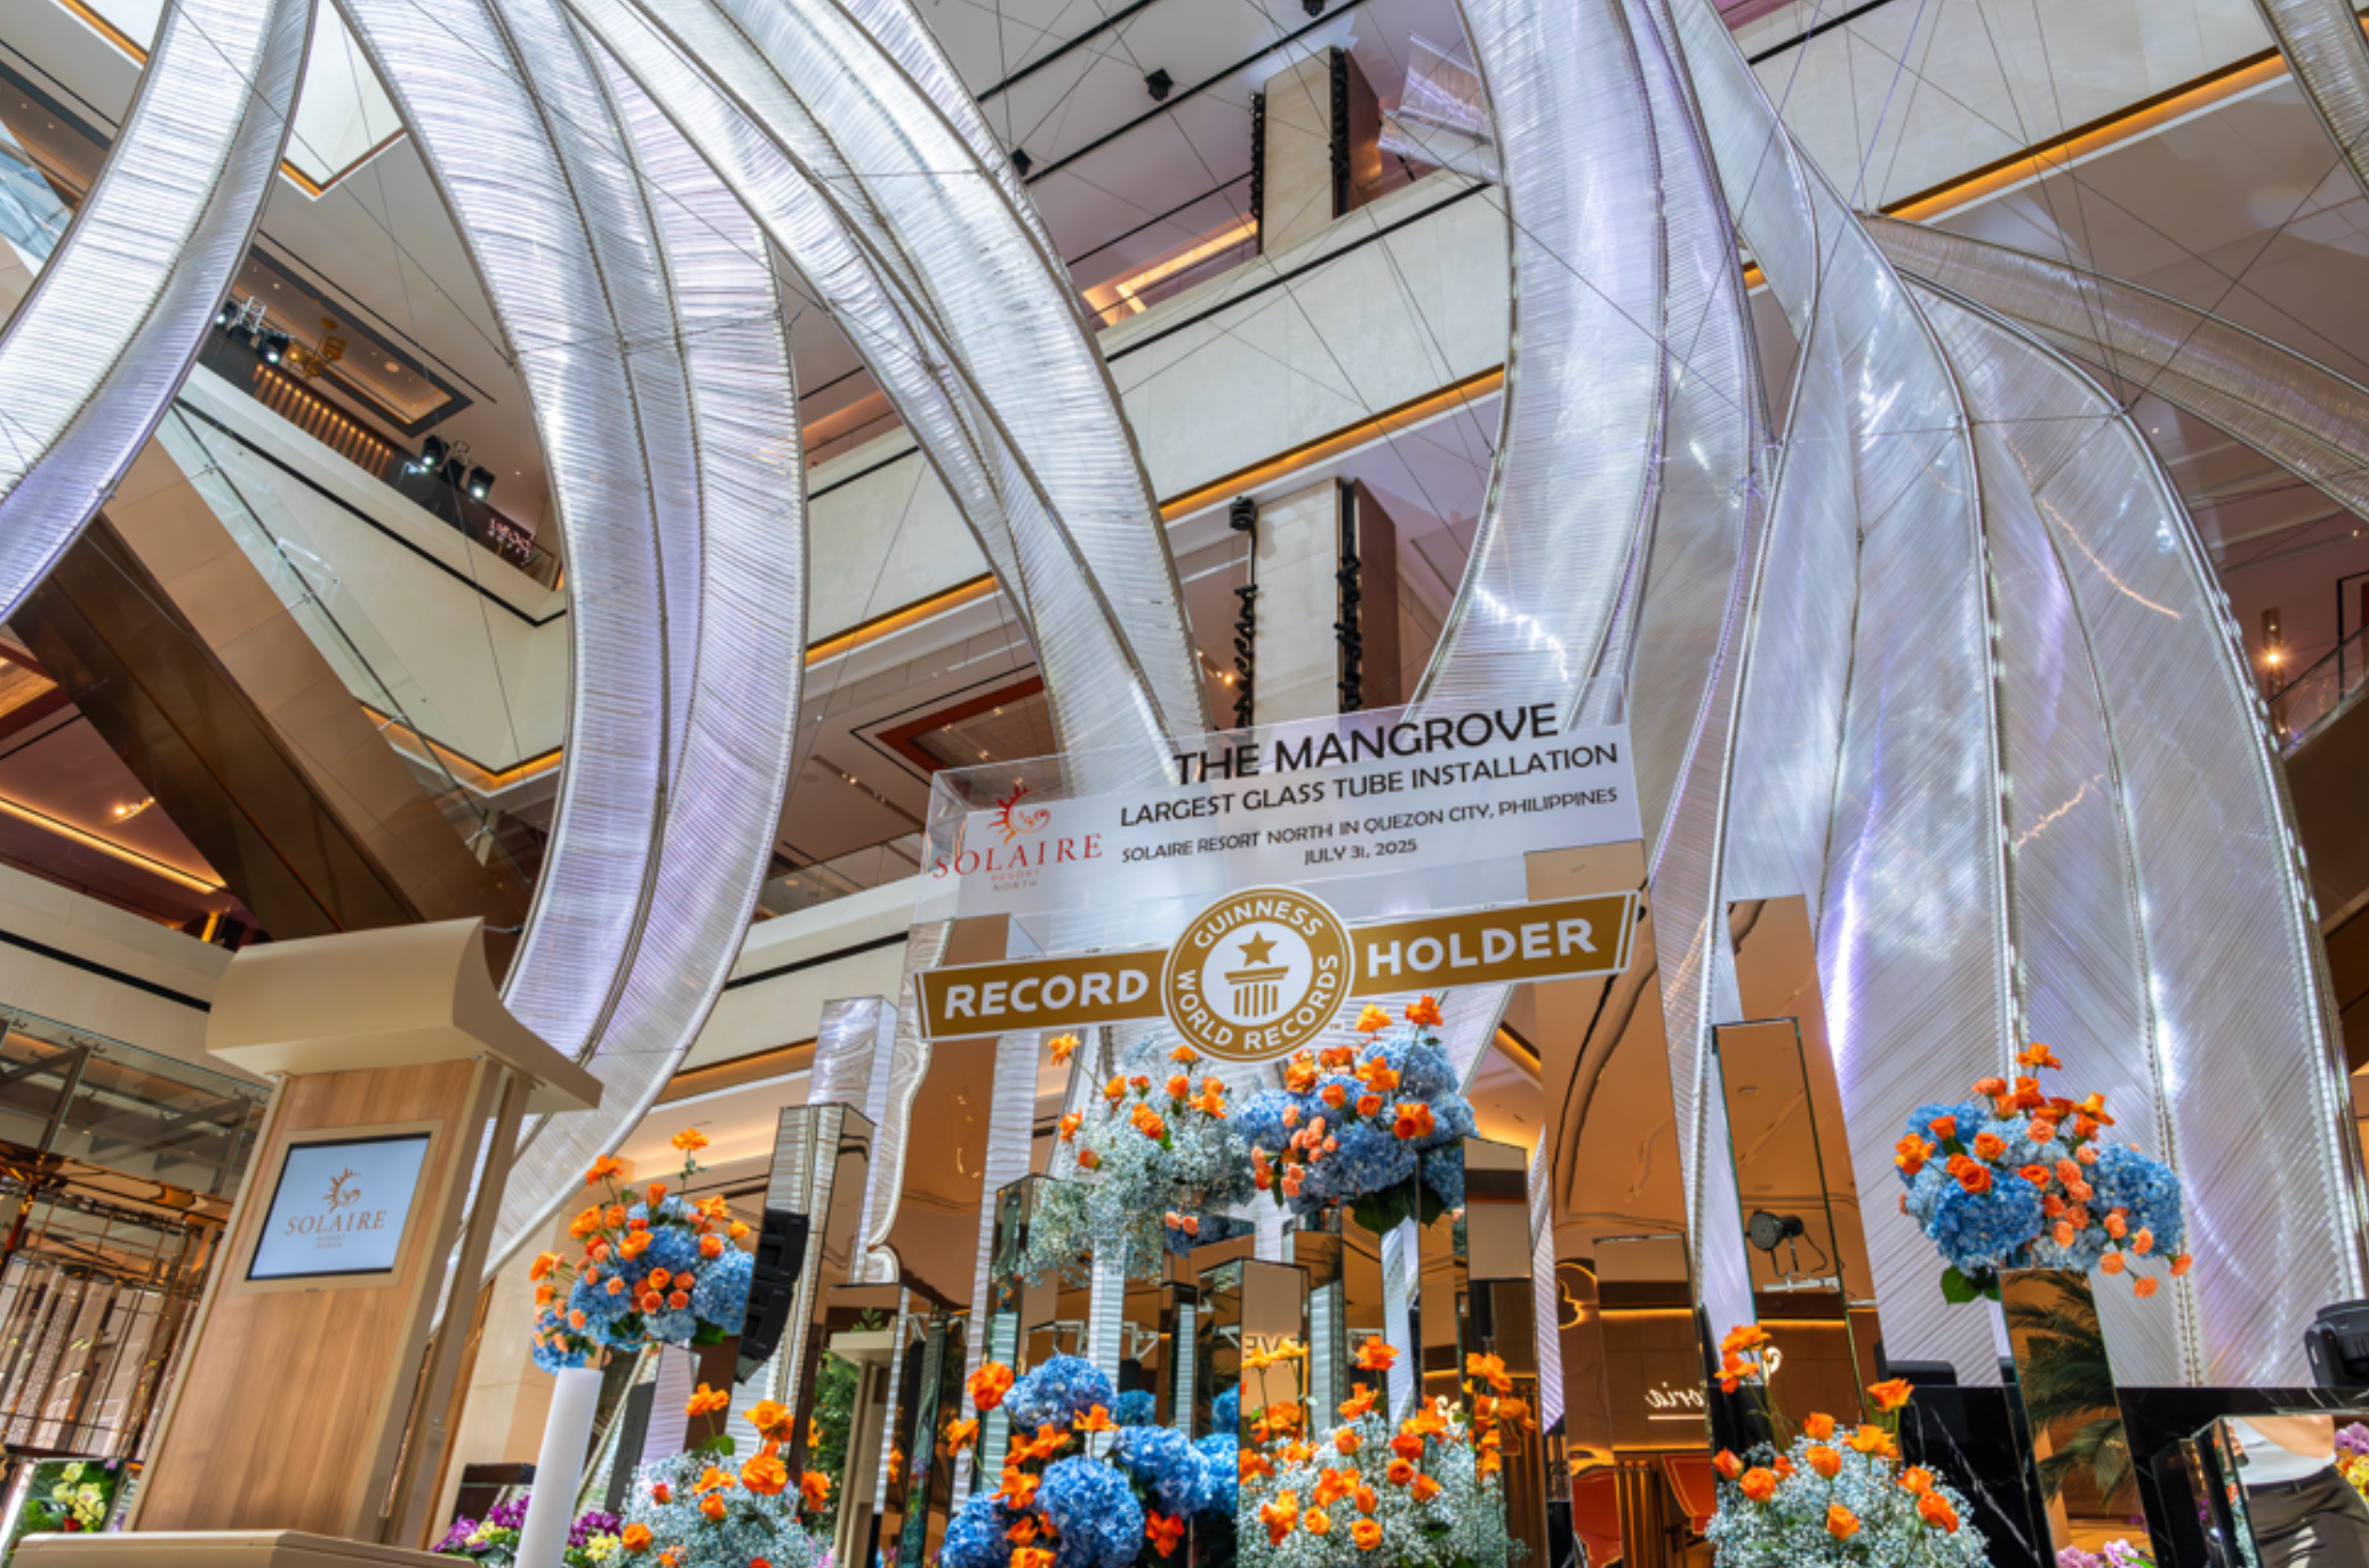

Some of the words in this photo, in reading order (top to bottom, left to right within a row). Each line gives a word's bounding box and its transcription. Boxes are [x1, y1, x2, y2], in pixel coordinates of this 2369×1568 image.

[1173, 744, 1260, 785] THE
[1275, 703, 1558, 772] MANGROVE
[1121, 793, 1235, 826] LARGEST
[1243, 781, 1324, 810] GLASS
[1333, 771, 1404, 798] TUBE
[1412, 743, 1617, 790] INSTALLATION
[932, 833, 1102, 878] SOLAIRE
[1122, 840, 1193, 863] SOLAIRE
[1198, 831, 1260, 853] RESORT
[1268, 823, 1333, 845] NORTH
[1339, 821, 1359, 836] IN
[1364, 809, 1443, 834] QUEZON
[1449, 804, 1494, 822] CITY,
[1499, 787, 1617, 817] PHILIPPINES
[1305, 846, 1346, 866] JULY
[1376, 838, 1417, 856] 2025
[991, 868, 1040, 882] RESORT
[1195, 899, 1324, 948] GUINNESS
[944, 969, 1149, 1019] RECORD
[1368, 918, 1597, 978] HOLDER
[1177, 969, 1233, 1046] WORLD
[1244, 955, 1338, 1050] RECORDS
[284, 1210, 386, 1236] SOLAIRE
